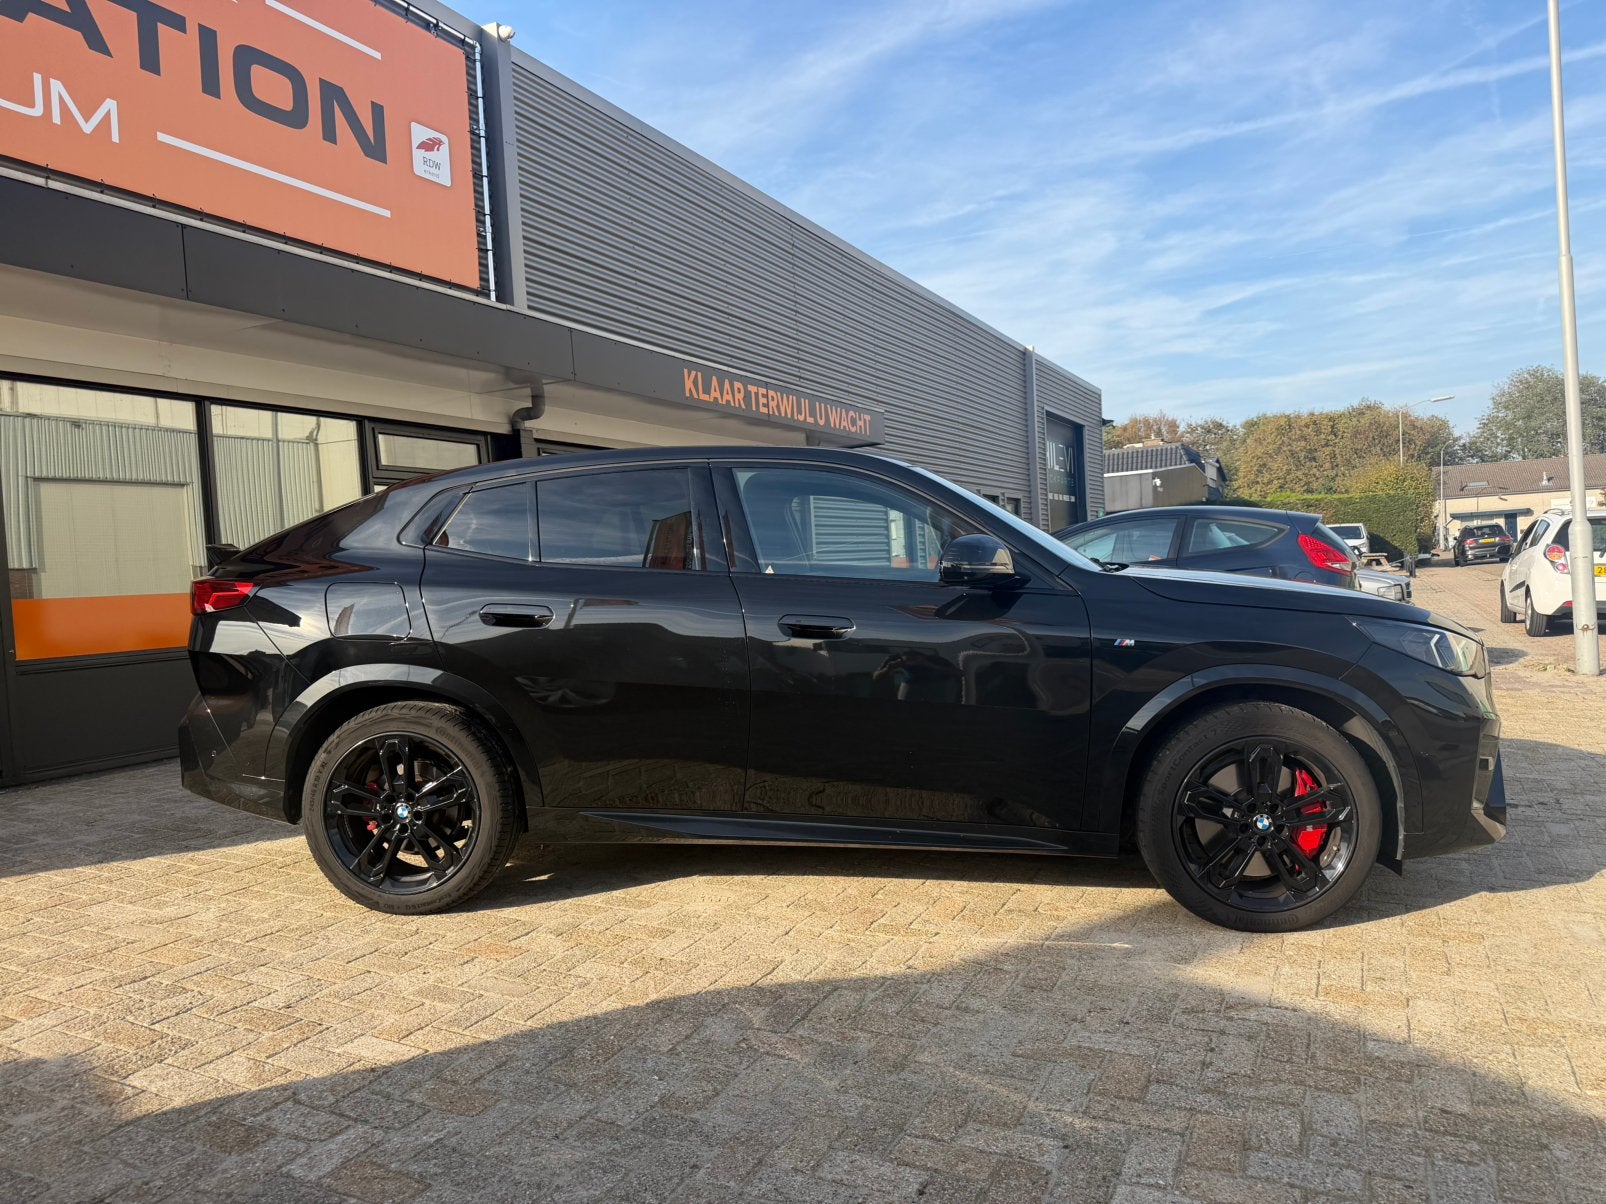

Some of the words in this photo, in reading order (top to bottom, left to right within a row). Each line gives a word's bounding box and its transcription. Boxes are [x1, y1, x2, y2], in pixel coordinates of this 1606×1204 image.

[423, 156, 441, 171] RDW
[684, 369, 746, 409] KLAAR
[748, 385, 815, 424] TERWIJL
[815, 400, 826, 426] U
[827, 404, 871, 436] WACHT
